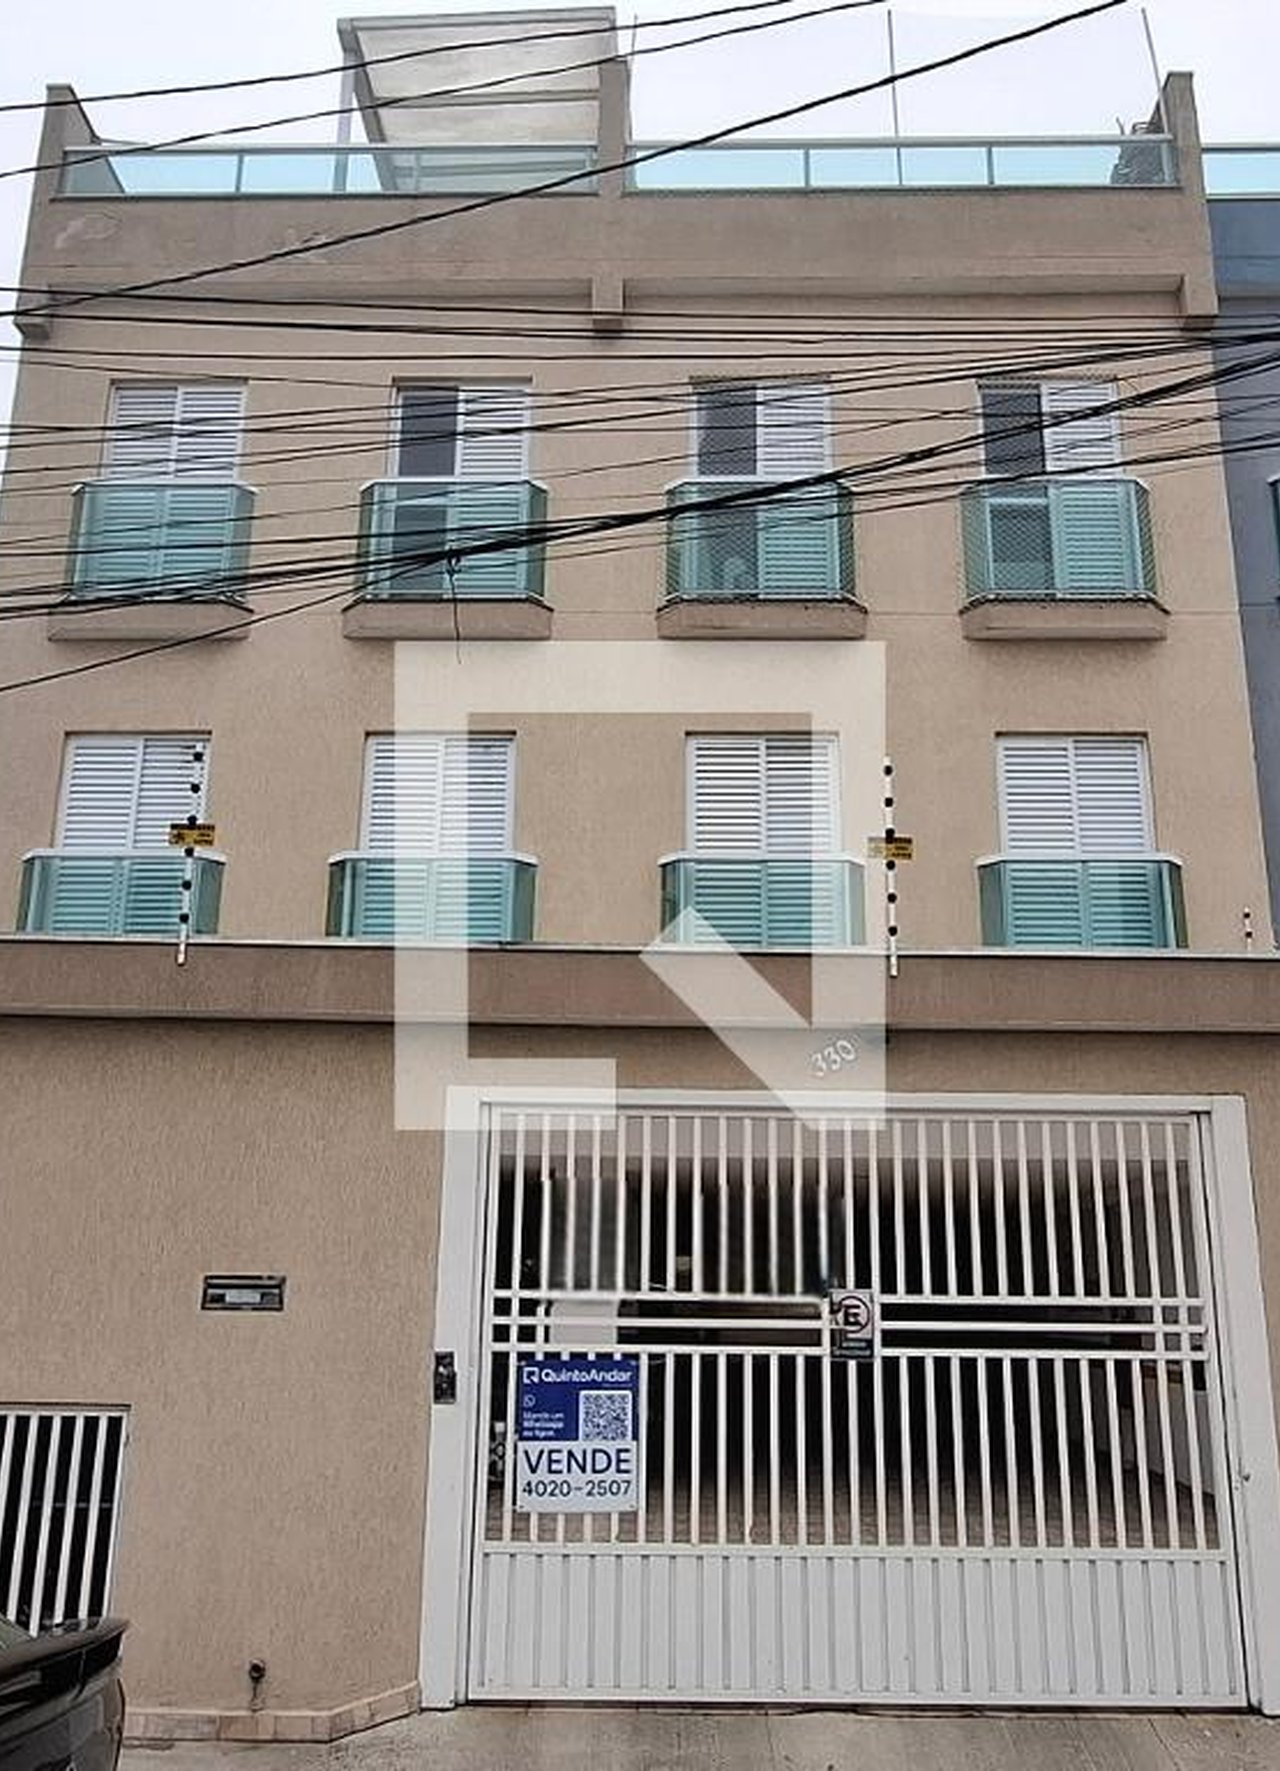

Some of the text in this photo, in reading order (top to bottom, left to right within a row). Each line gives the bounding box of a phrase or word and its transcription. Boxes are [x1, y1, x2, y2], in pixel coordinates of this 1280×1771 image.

[811, 1040, 855, 1076] 330
[541, 1368, 632, 1382] QuintoAndar
[524, 1448, 632, 1474] VENDE
[523, 1480, 631, 1497] 4020-2507
